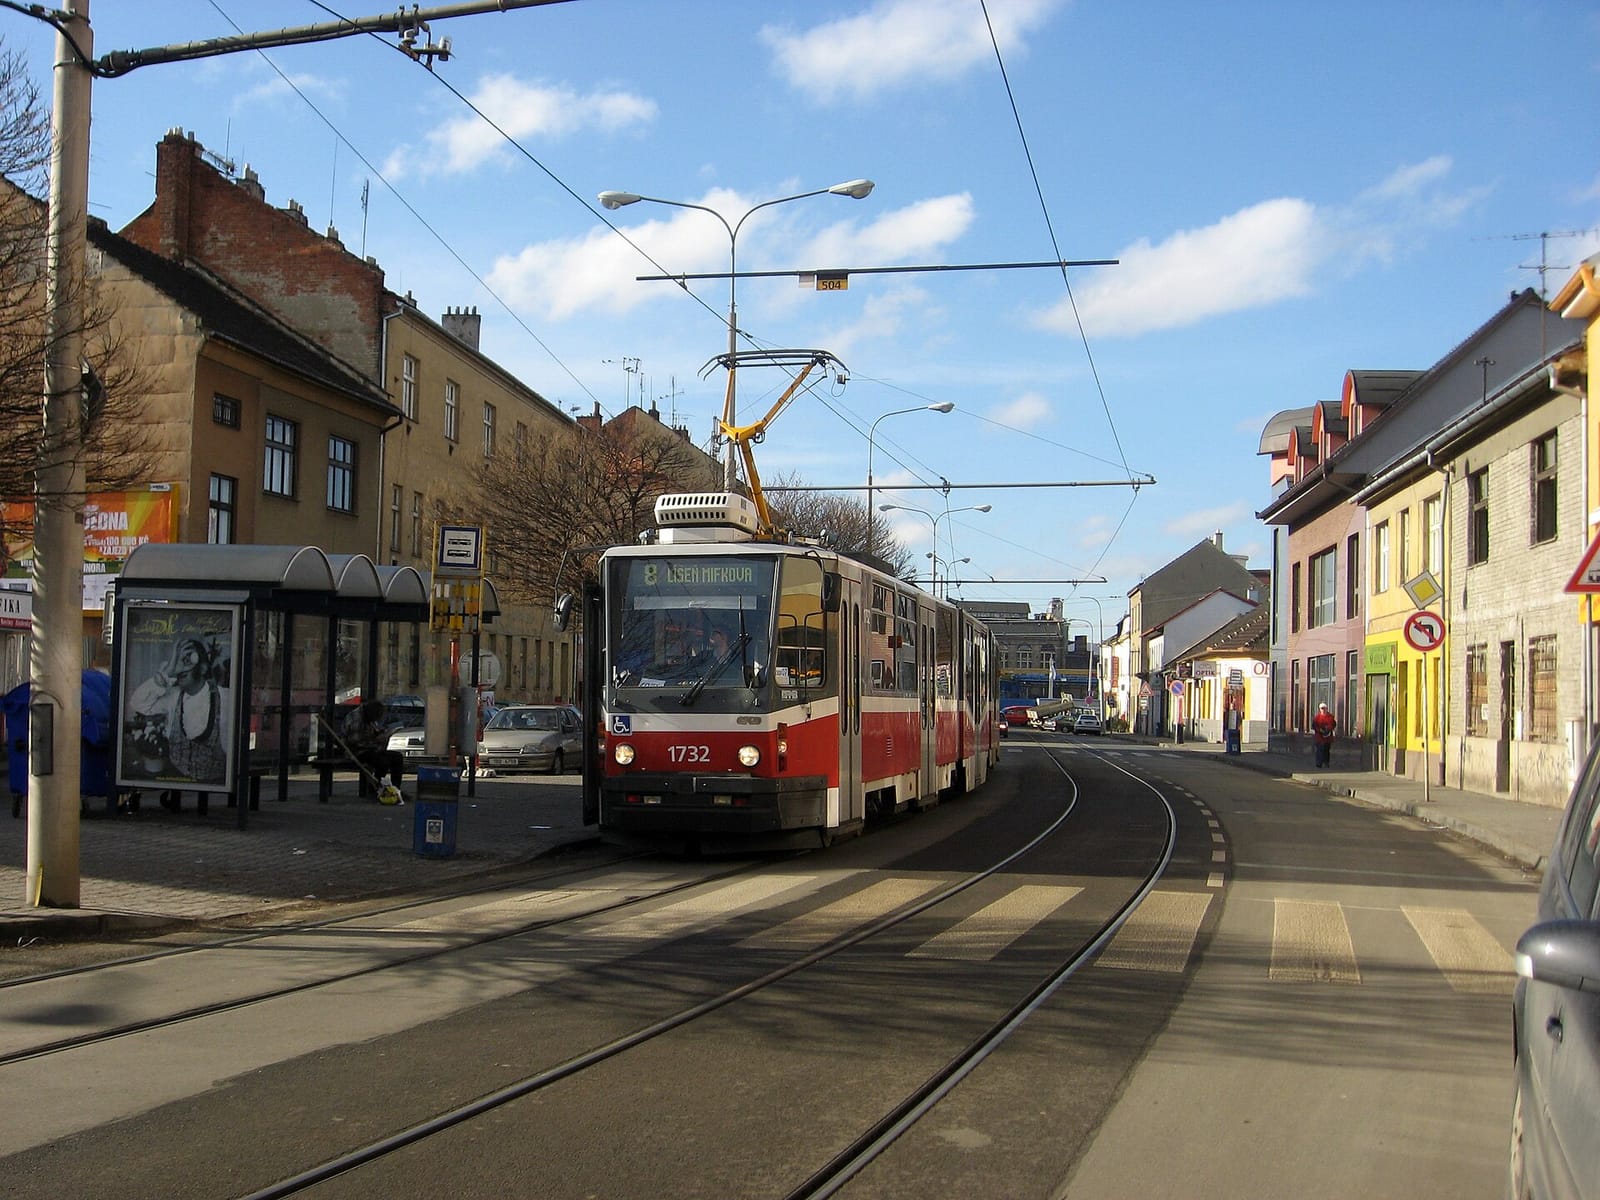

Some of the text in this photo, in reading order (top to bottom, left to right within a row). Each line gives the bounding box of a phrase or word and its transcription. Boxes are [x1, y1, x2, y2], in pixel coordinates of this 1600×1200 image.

[822, 281, 841, 290] 504
[644, 563, 657, 586] 8
[702, 567, 752, 583] MIFKOVA
[667, 745, 711, 762] 1732
